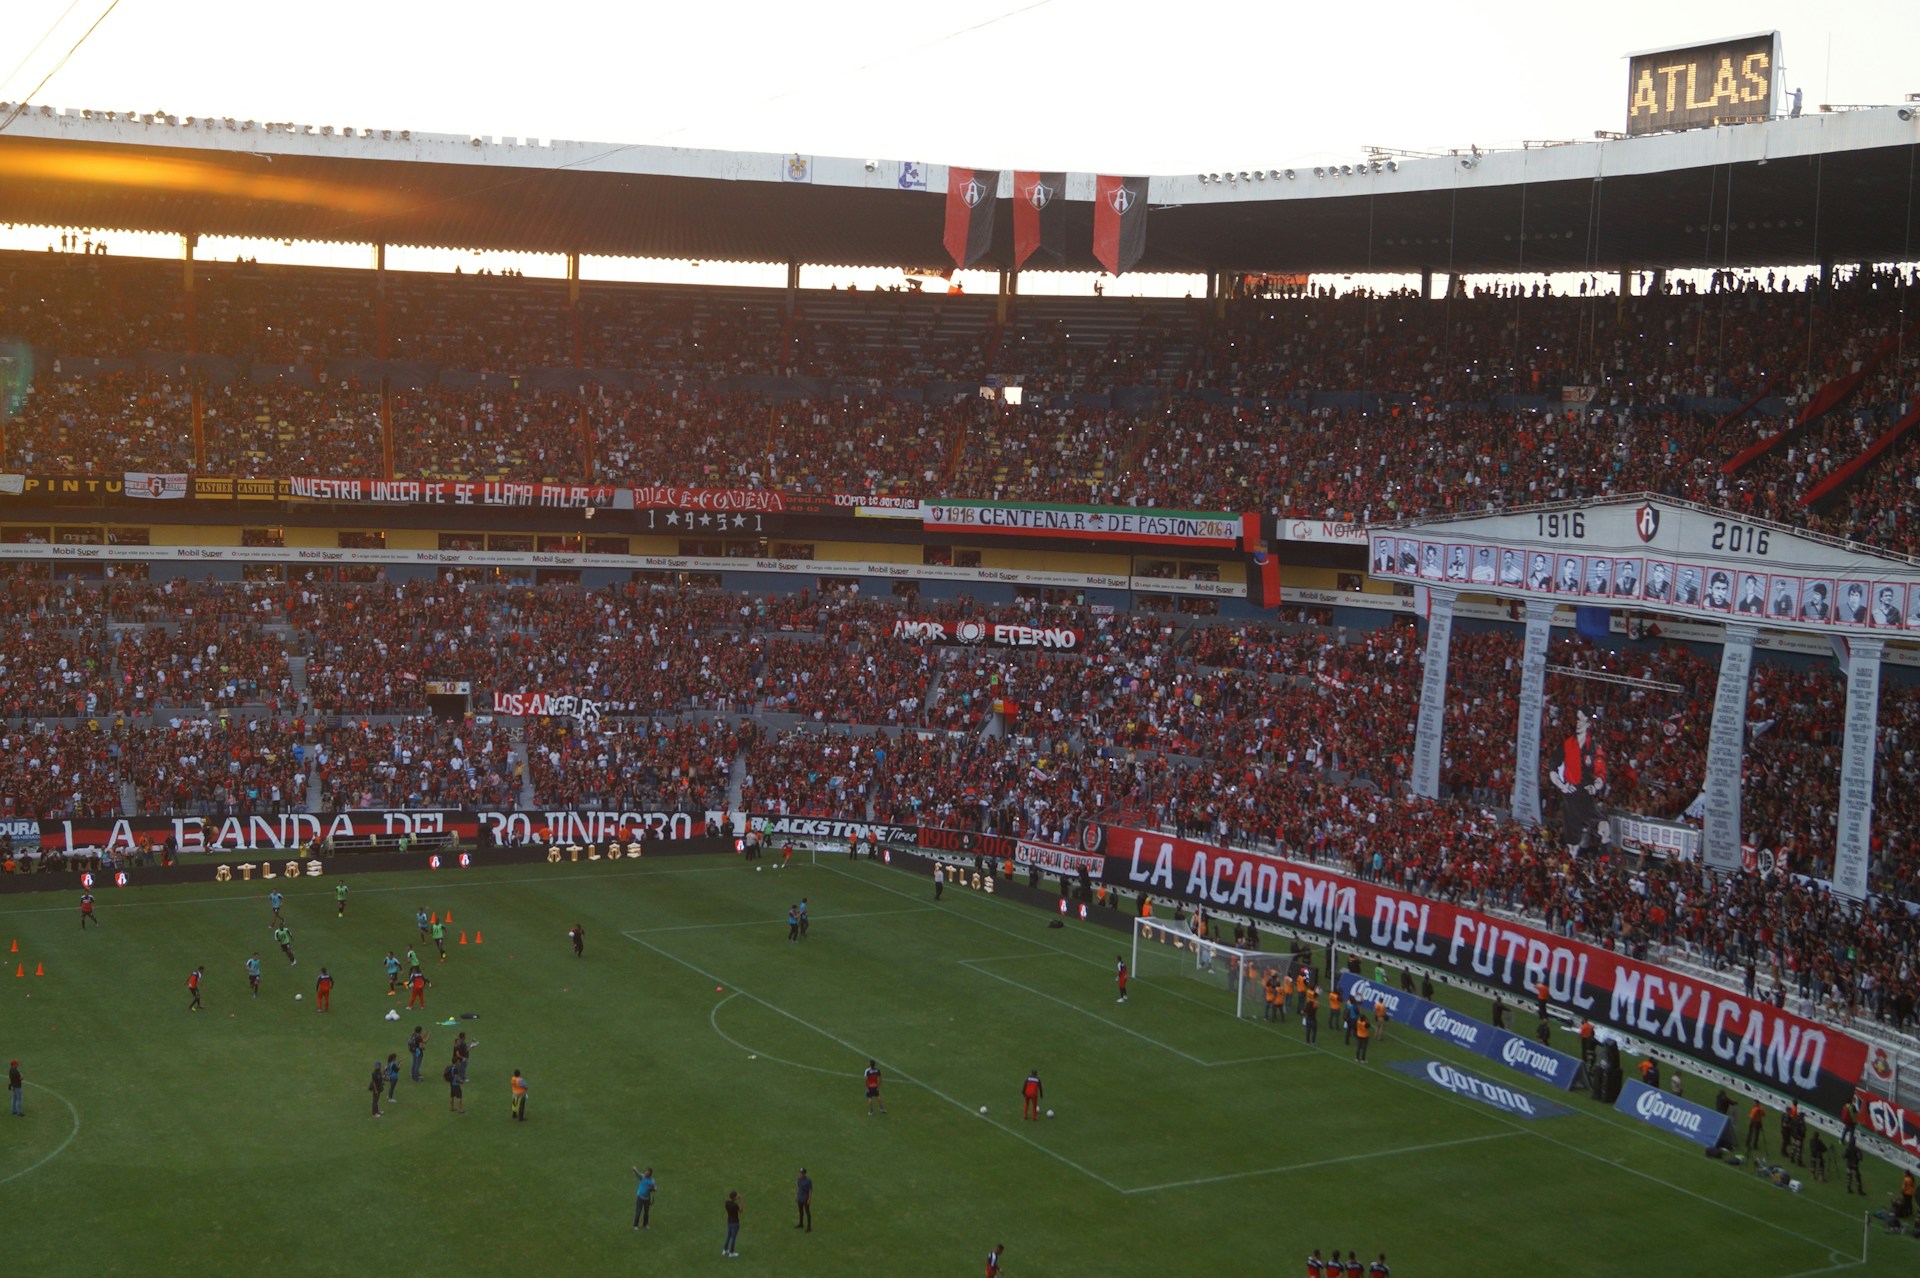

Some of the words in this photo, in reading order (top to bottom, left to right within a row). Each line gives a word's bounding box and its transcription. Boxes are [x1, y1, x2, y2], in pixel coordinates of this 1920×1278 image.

[1630, 52, 1769, 116] ATLAS
[195, 483, 233, 493] CASTHER
[238, 483, 274, 494] CASTHER
[291, 476, 361, 500] NUESTRA
[371, 480, 420, 502] UNICA
[425, 482, 445, 505] FE
[455, 483, 475, 505] SE
[484, 482, 533, 506] LLAMA
[540, 485, 590, 508] ATLAS
[946, 507, 975, 523] 1916
[1108, 515, 1133, 532] DE
[1139, 517, 1199, 537] PASION
[1537, 512, 1585, 538] 1916
[1712, 521, 1770, 555] 2016
[53, 547, 76, 555] Mobil
[77, 548, 100, 557] Super
[202, 549, 223, 558] Super
[299, 550, 320, 558] Mobil
[323, 551, 343, 559] Super
[417, 552, 438, 560] Mobil
[440, 553, 460, 561] Super
[533, 555, 553, 563] Mobil
[555, 556, 575, 564] Super
[646, 557, 667, 565] Mobil
[668, 559, 688, 567] Super
[779, 562, 798, 570] Super
[868, 565, 888, 573] Mobil
[890, 566, 909, 575] Super
[978, 570, 998, 578] Mobil
[1000, 571, 1018, 580] Super
[1087, 576, 1106, 584] Mobil
[1108, 578, 1127, 587] Super
[1195, 583, 1214, 591] Mobil
[1216, 584, 1234, 593] Super
[1300, 591, 1318, 600] Mobil
[1320, 593, 1338, 602] Super
[893, 620, 947, 641] AMOR
[994, 624, 1076, 648] ETERNO
[494, 691, 524, 716] LOS
[528, 693, 602, 721] ANGELES
[171, 814, 354, 850] BANDA
[751, 817, 889, 841] BLACKSTONE
[888, 827, 918, 843] Tires
[924, 829, 961, 851] 1916
[973, 833, 1012, 858] 2016
[1129, 837, 1174, 891] LA
[1186, 850, 1358, 938] ACADEMIA
[1369, 895, 1437, 957] DEL
[1447, 914, 1595, 1010] FUTBOL
[1609, 965, 1827, 1091] MEXICANO
[1350, 978, 1399, 1012] Corona
[1423, 1007, 1478, 1044] Corona
[1501, 1036, 1559, 1076] Corona
[1425, 1060, 1536, 1114] Corona
[1635, 1089, 1702, 1132] Corona
[1868, 1100, 1918, 1147] GDL
